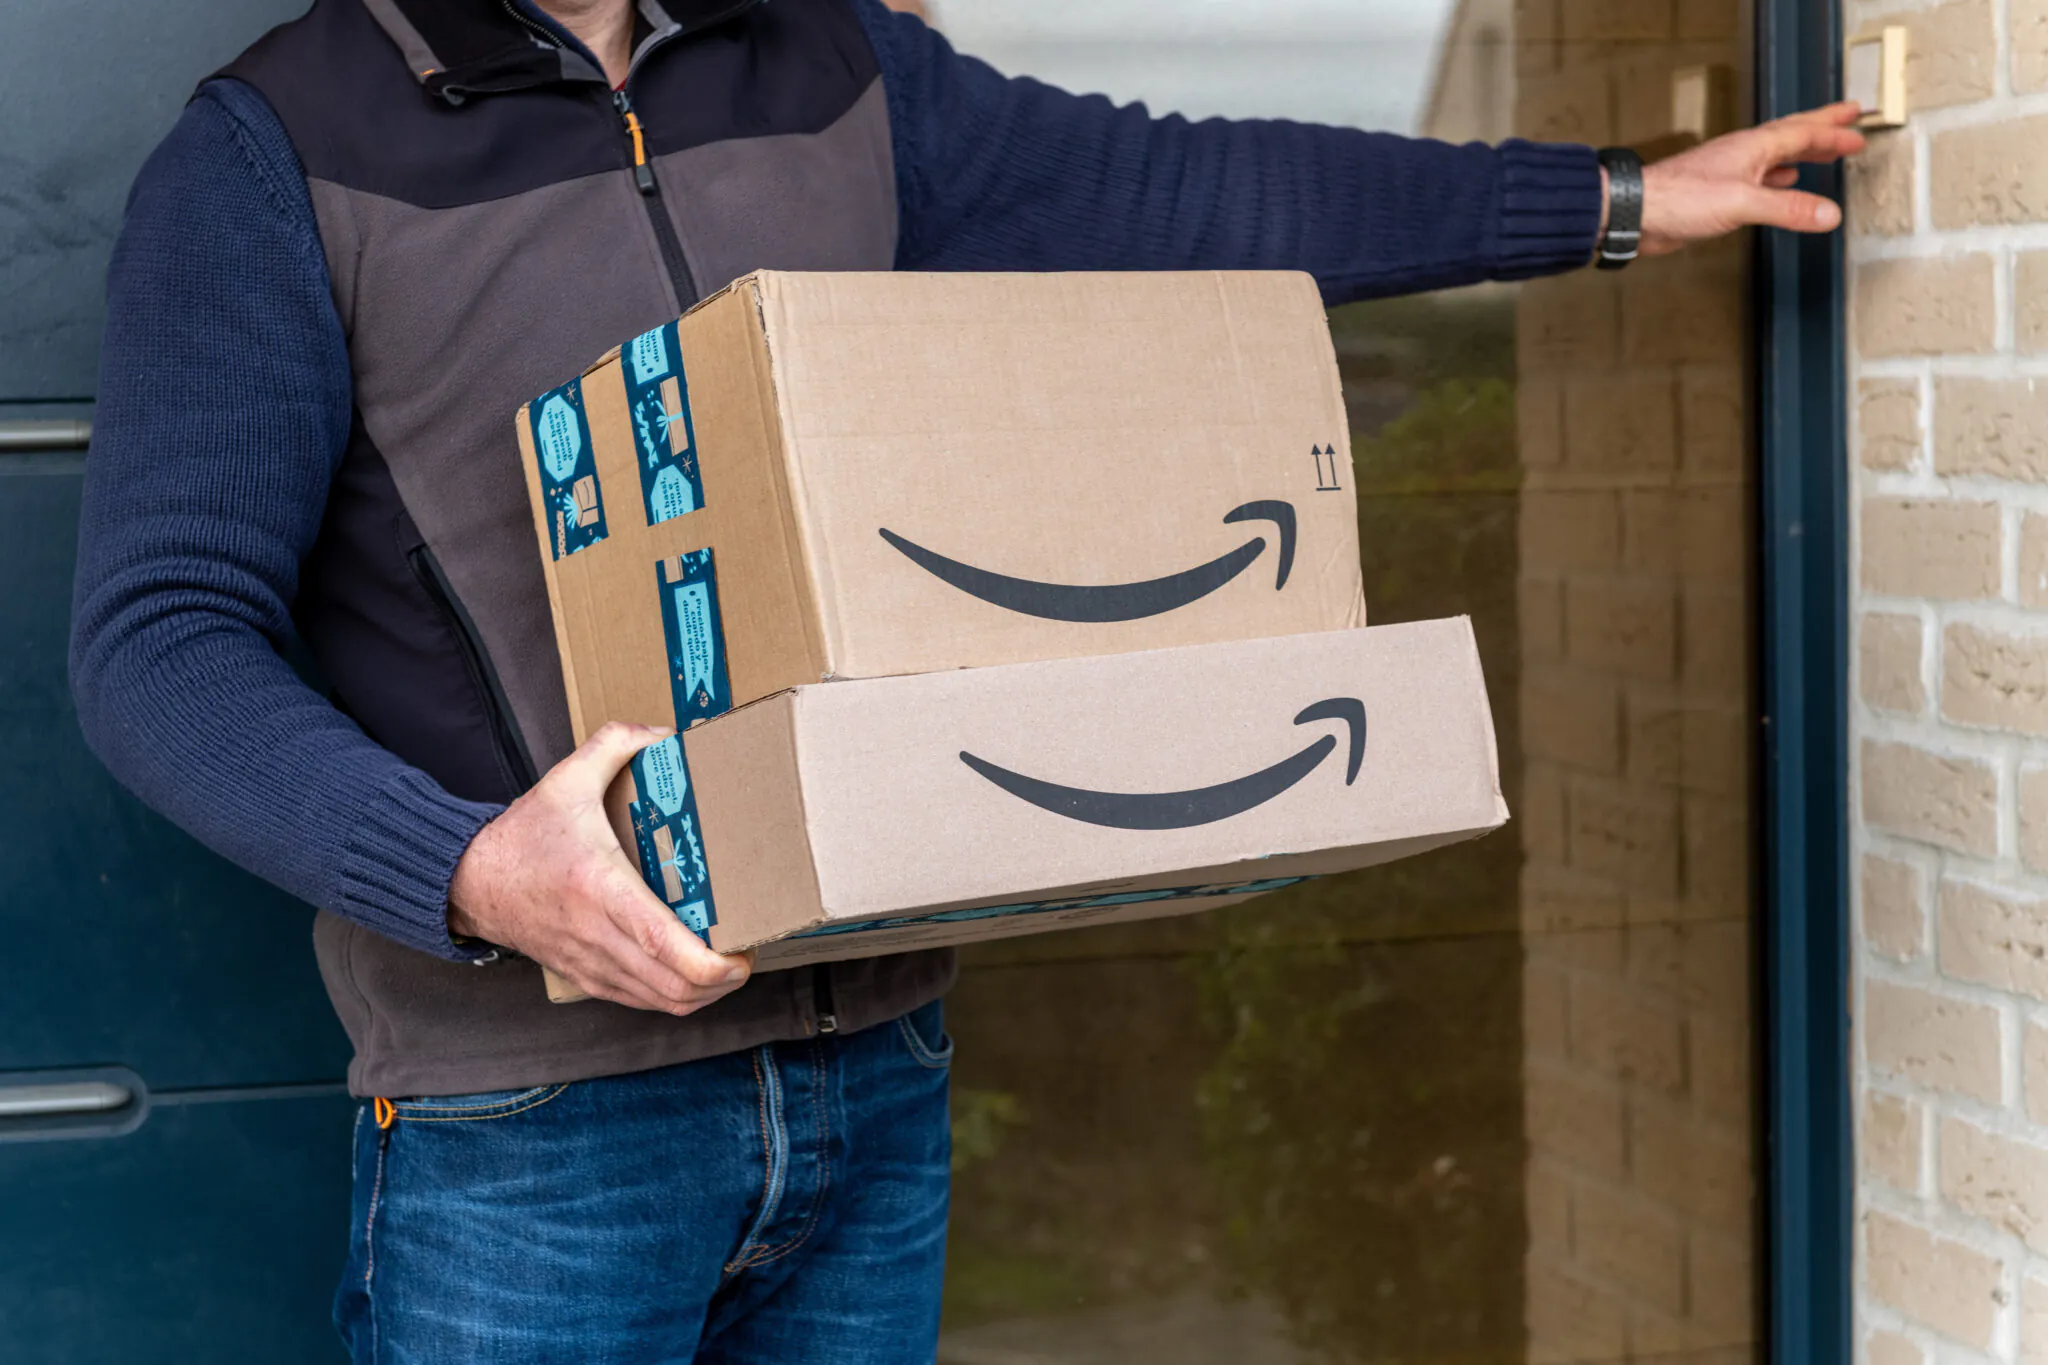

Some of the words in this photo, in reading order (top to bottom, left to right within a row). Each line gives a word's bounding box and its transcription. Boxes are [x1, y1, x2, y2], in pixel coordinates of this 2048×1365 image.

[555, 421, 567, 461] quando
[565, 436, 573, 461] dove
[683, 600, 691, 634] donde
[691, 611, 700, 651] cuando
